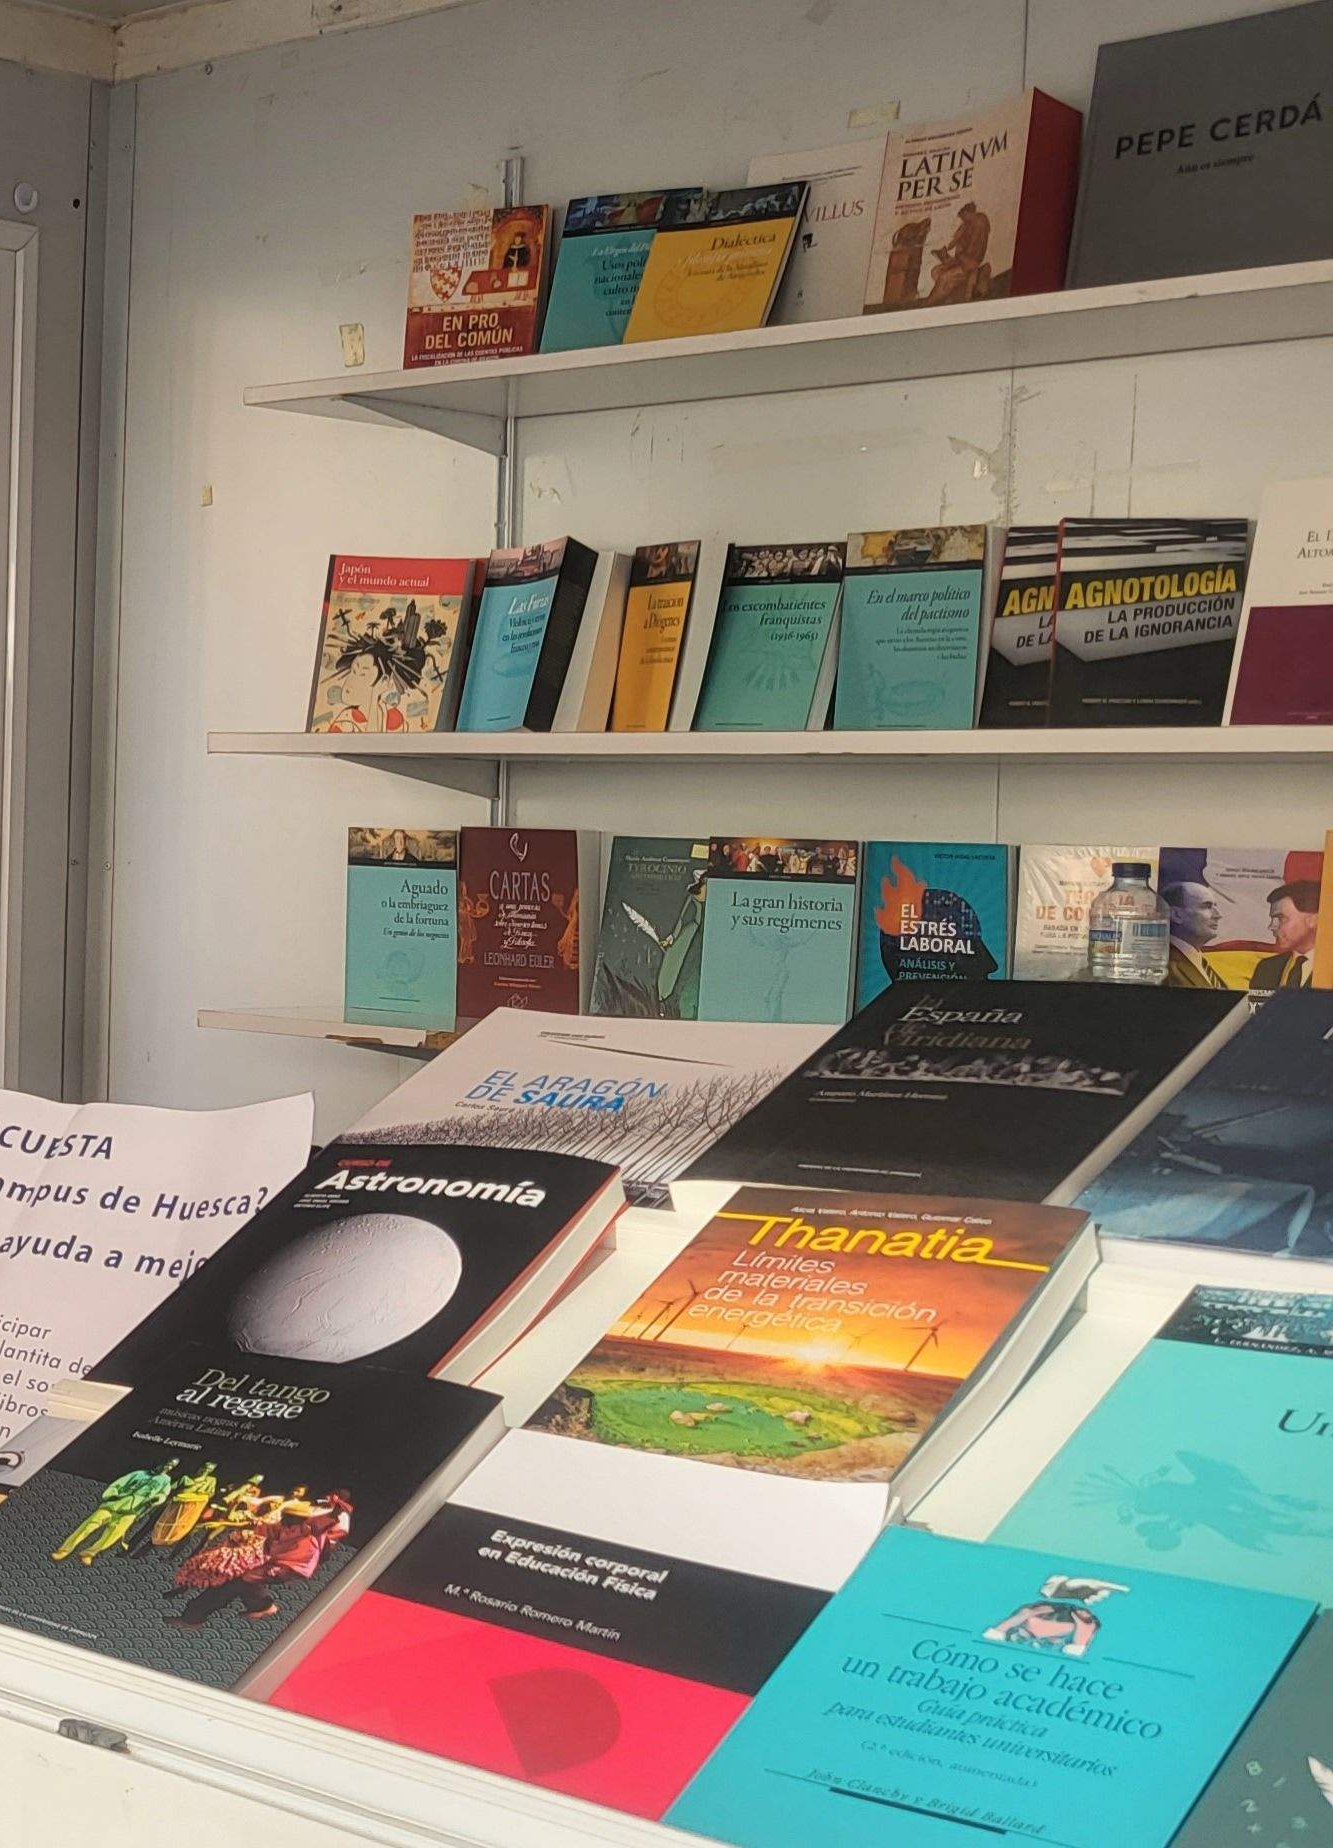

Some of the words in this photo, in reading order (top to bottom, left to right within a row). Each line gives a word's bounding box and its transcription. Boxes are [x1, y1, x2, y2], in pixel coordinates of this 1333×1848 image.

[1114, 124, 1196, 160] PEPE
[1209, 92, 1322, 142] CERDÁ
[900, 131, 1008, 178] LATINVM
[897, 177, 943, 201] PER
[949, 167, 973, 192] SE
[442, 315, 463, 332] EN
[468, 313, 499, 330] PRO
[425, 334, 452, 350] DEL
[457, 325, 513, 347] COMÚN
[339, 562, 371, 576] Japón
[339, 577, 345, 585] y
[347, 574, 357, 585] el
[359, 575, 397, 586] mundo
[398, 576, 430, 587] actual
[866, 589, 884, 604] En
[885, 588, 896, 603] el
[897, 592, 929, 602] marco
[930, 585, 971, 606] político
[1064, 564, 1236, 610] AGNOTOLOGÍA
[741, 597, 826, 612] excombatientes
[901, 605, 918, 621] del
[918, 607, 970, 625] pactismo
[1108, 609, 1128, 624] LA
[1133, 596, 1235, 622] PRODUCCIÓN
[759, 613, 822, 628] franquistas
[1084, 629, 1104, 644] DE
[1109, 626, 1129, 641] LA
[1134, 615, 1232, 638] IGNORANCIA
[400, 879, 449, 898] Aguado
[489, 870, 551, 902] CARTAS
[381, 900, 387, 908] o
[388, 897, 396, 908] la
[397, 899, 449, 916] embriaguez
[731, 891, 750, 908] La
[752, 896, 785, 913] gran
[788, 892, 843, 912] historia
[900, 903, 919, 919] EL
[394, 912, 404, 923] de
[405, 913, 415, 924] la
[415, 913, 449, 926] fortuna
[731, 915, 741, 925] y
[741, 915, 764, 927] sus
[766, 913, 842, 932] regímenes
[900, 918, 957, 937] ESTRÉS
[899, 936, 975, 955] LABORAL
[899, 957, 946, 971] ANÁLISIS
[948, 961, 955, 971] Y
[897, 1006, 1024, 1026] España
[483, 1070, 518, 1088] EL
[523, 1075, 668, 1098] ARAGÓN
[465, 1085, 514, 1101] DE
[514, 1090, 625, 1112] SAURA
[314, 1169, 546, 1208] Astronomía
[99, 1185, 141, 1214] de
[151, 1186, 269, 1221] Huesca?
[746, 1215, 996, 1263] Thanatia
[103, 1249, 123, 1269] a
[732, 1250, 835, 1274] Límites
[717, 1270, 869, 1297] materiales
[687, 1303, 843, 1333] energética
[703, 1286, 743, 1302] de
[752, 1288, 779, 1306] la
[789, 1292, 937, 1323] transición
[2, 1369, 22, 1387] el
[68, 1356, 93, 1376] de
[192, 1368, 250, 1392] Del
[249, 1378, 331, 1405] tango
[175, 1387, 212, 1405] al
[208, 1394, 304, 1420] reggae
[490, 1529, 582, 1563] Expresión
[584, 1553, 670, 1584] corporal
[478, 1546, 502, 1560] en
[504, 1551, 599, 1586] Educación
[602, 1575, 658, 1601] Física
[911, 1638, 999, 1674] Cómo
[1005, 1660, 1041, 1683] se
[1047, 1663, 1125, 1701] hace
[841, 1655, 880, 1680] un
[886, 1664, 988, 1703] trabajo
[993, 1687, 1163, 1740] académico
[917, 1697, 967, 1722] Guía
[962, 1707, 1049, 1740] práctica
[821, 1701, 875, 1722] para
[875, 1711, 981, 1748] estudiantes
[981, 1733, 1118, 1778] universitarios
